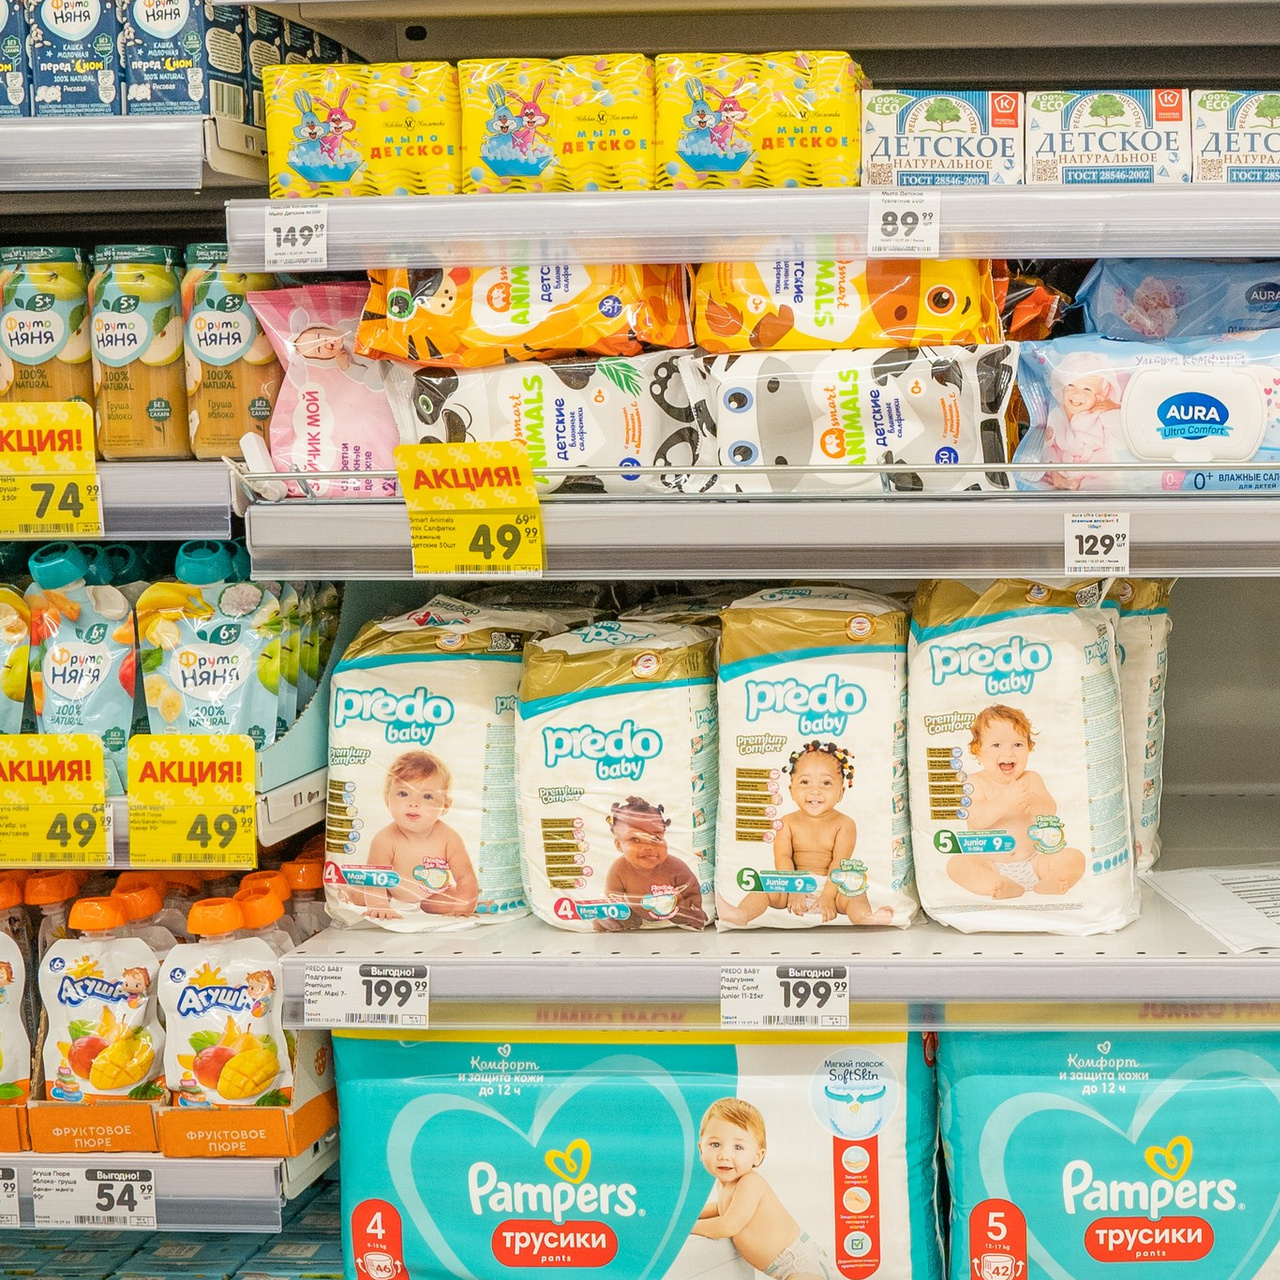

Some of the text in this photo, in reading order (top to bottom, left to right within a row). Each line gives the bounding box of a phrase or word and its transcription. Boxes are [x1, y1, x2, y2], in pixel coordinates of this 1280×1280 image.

[875, 102, 900, 113] ECO
[384, 133, 438, 144] МЫЛО
[370, 143, 454, 159] ДЕТСКОЕ
[871, 136, 1015, 162] ДЕТСКОЕ
[894, 159, 993, 170] НАТУРАЛЬНОЕ
[1067, 170, 1150, 182] ГОСТ 28546-2002
[881, 212, 933, 236] 89 99
[273, 224, 324, 248] 149 99
[1166, 405, 1220, 420] AURA
[1164, 425, 1224, 436] Ultra Comfort
[413, 466, 521, 489] АКЦИЯ!
[1219, 473, 1260, 481] ВЛАЖНЫЕ
[31, 482, 100, 519] 74 99
[469, 525, 537, 560] 49 99
[1075, 535, 1114, 555] 129
[930, 636, 1052, 685] predo
[139, 761, 242, 786] АКЦИЯ!
[186, 813, 252, 848] 49 99
[371, 967, 415, 977] Выгодно!
[362, 979, 412, 1007] 199
[829, 1069, 879, 1083] SoftSkin
[186, 1130, 266, 1141] ФРУКТОВОЕ
[209, 1141, 246, 1152] ПЮРЕ
[96, 1184, 137, 1212] 54
[1063, 1160, 1236, 1219] Pampers
[1096, 1227, 1202, 1247] трусики
[1136, 1249, 1166, 1258] pants
